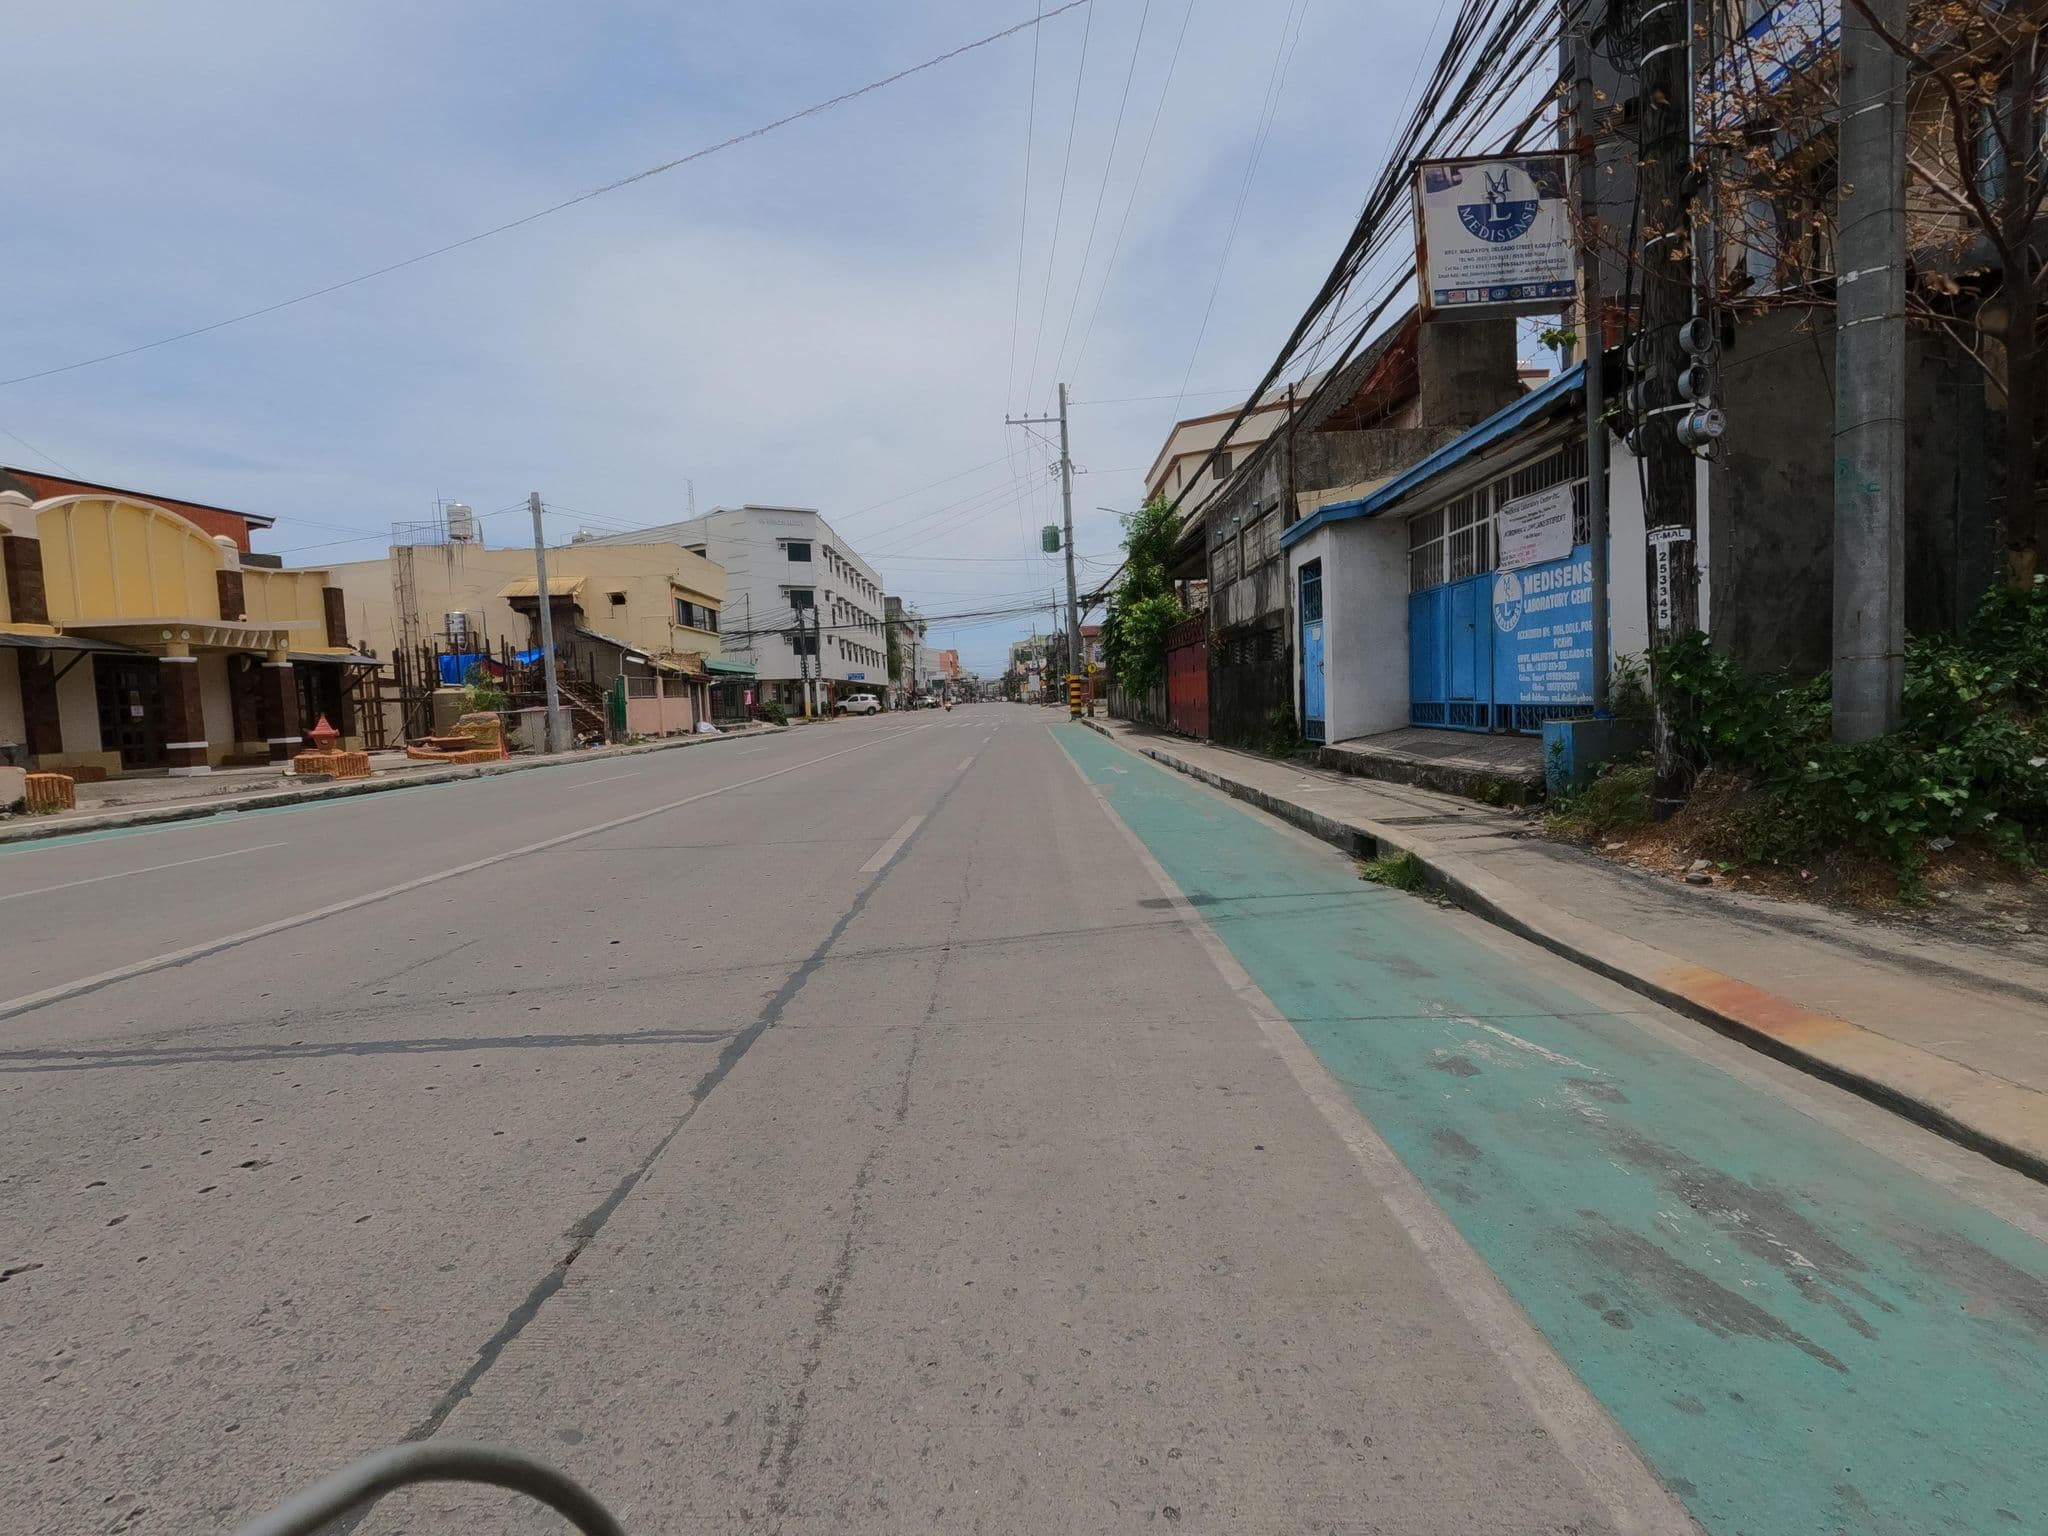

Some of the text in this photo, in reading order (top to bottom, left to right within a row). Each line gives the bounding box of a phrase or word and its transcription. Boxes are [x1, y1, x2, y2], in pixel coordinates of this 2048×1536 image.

[1460, 201, 1537, 242] MEDISENSE
[1523, 561, 1593, 594] MEDISENS
[1659, 552, 1668, 619] 253345
[1523, 587, 1593, 613] LABORATORY CENT
